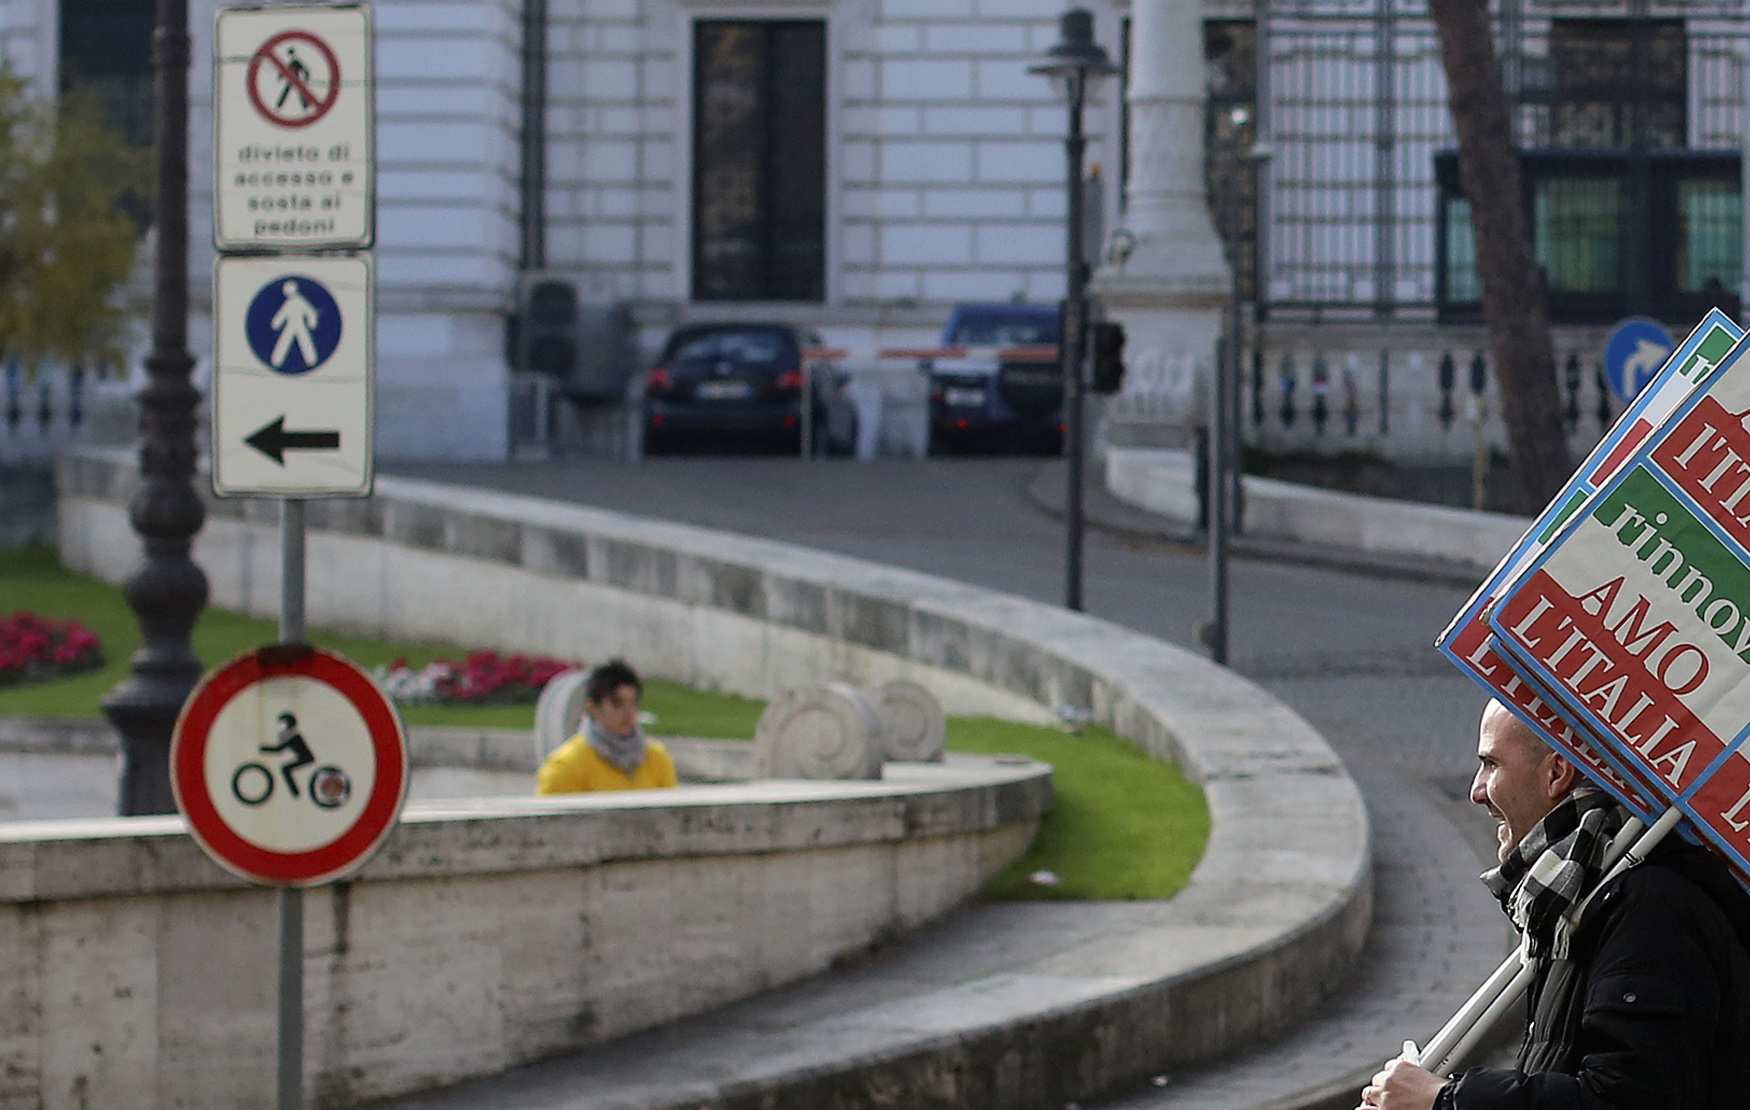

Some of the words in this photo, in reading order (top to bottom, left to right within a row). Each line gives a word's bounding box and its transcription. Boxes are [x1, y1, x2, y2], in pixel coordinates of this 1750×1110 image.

[238, 144, 320, 162] divieto
[328, 143, 350, 161] di
[234, 171, 333, 186] accesso
[341, 171, 354, 185] e
[248, 194, 312, 211] sosta
[321, 194, 341, 210] ai
[255, 217, 335, 235] pedoni
[1576, 576, 1709, 696] AMO
[1510, 595, 1698, 788] L'ITALIA
